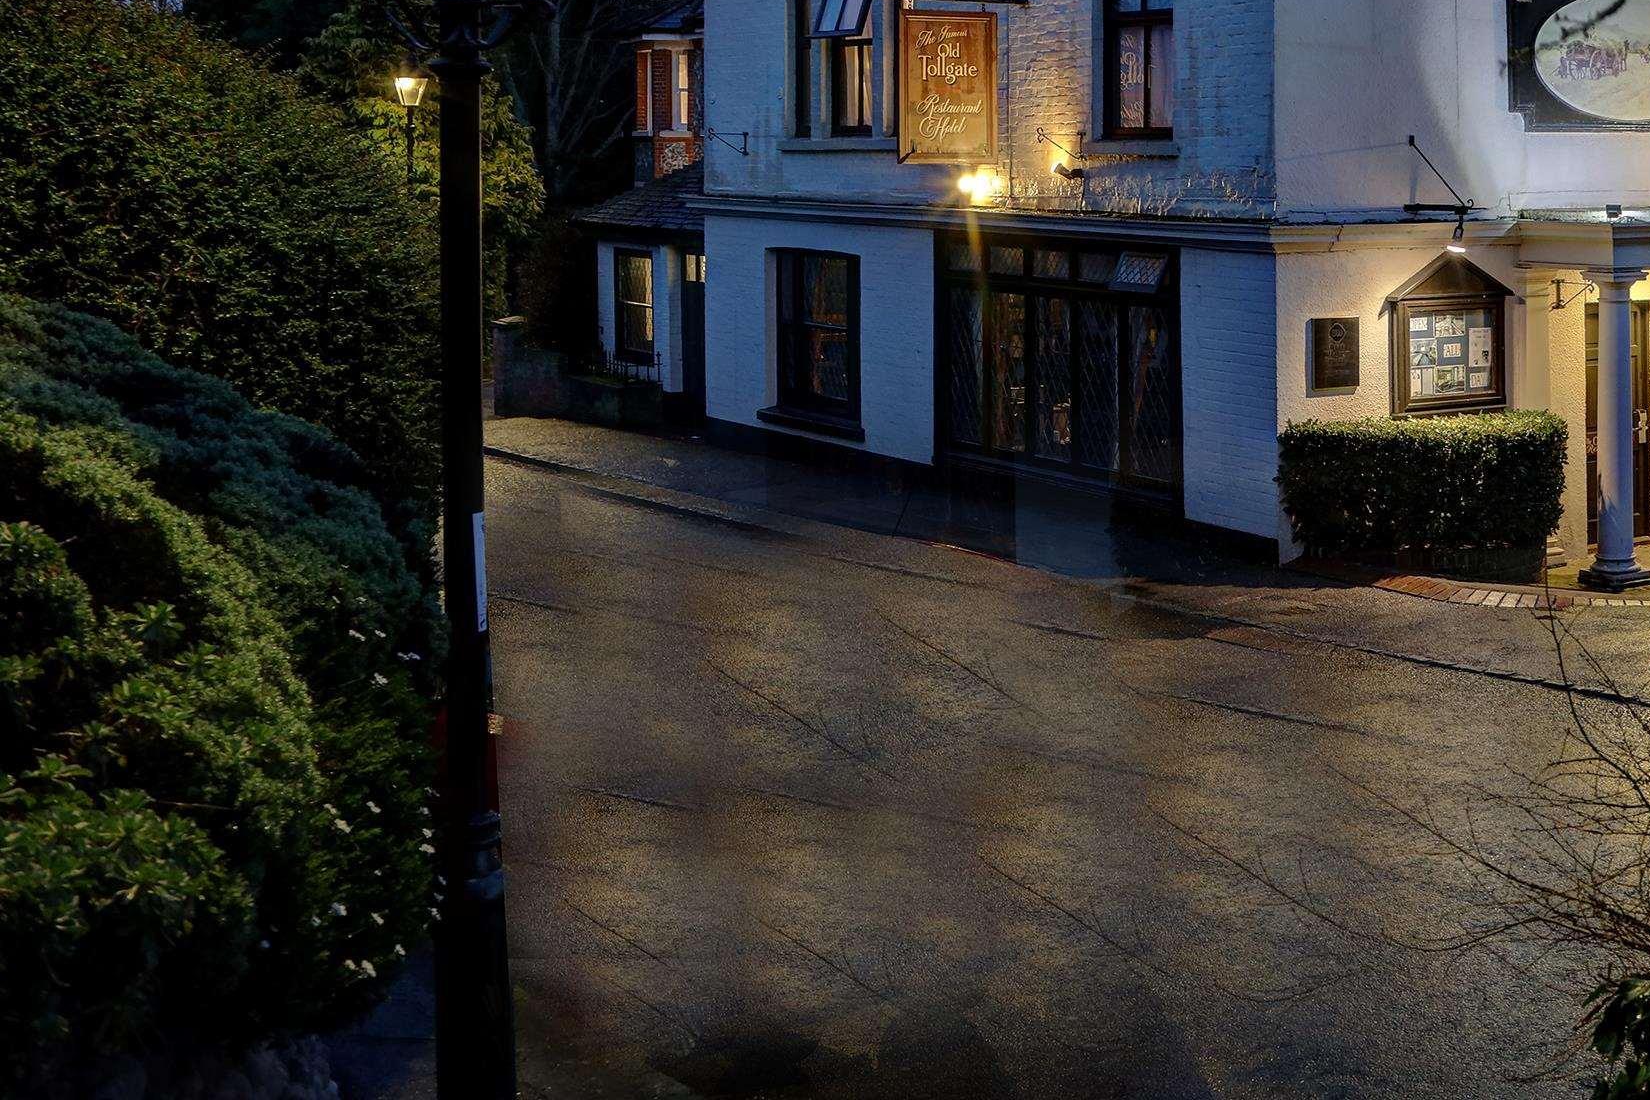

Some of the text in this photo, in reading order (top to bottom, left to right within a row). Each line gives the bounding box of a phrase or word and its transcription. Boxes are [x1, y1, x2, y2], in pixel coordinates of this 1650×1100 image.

[915, 30, 937, 48] The
[938, 43, 960, 58] Old
[918, 55, 979, 85] Tollgate
[917, 93, 983, 118] Restaurant
[919, 115, 967, 143] Hotel
